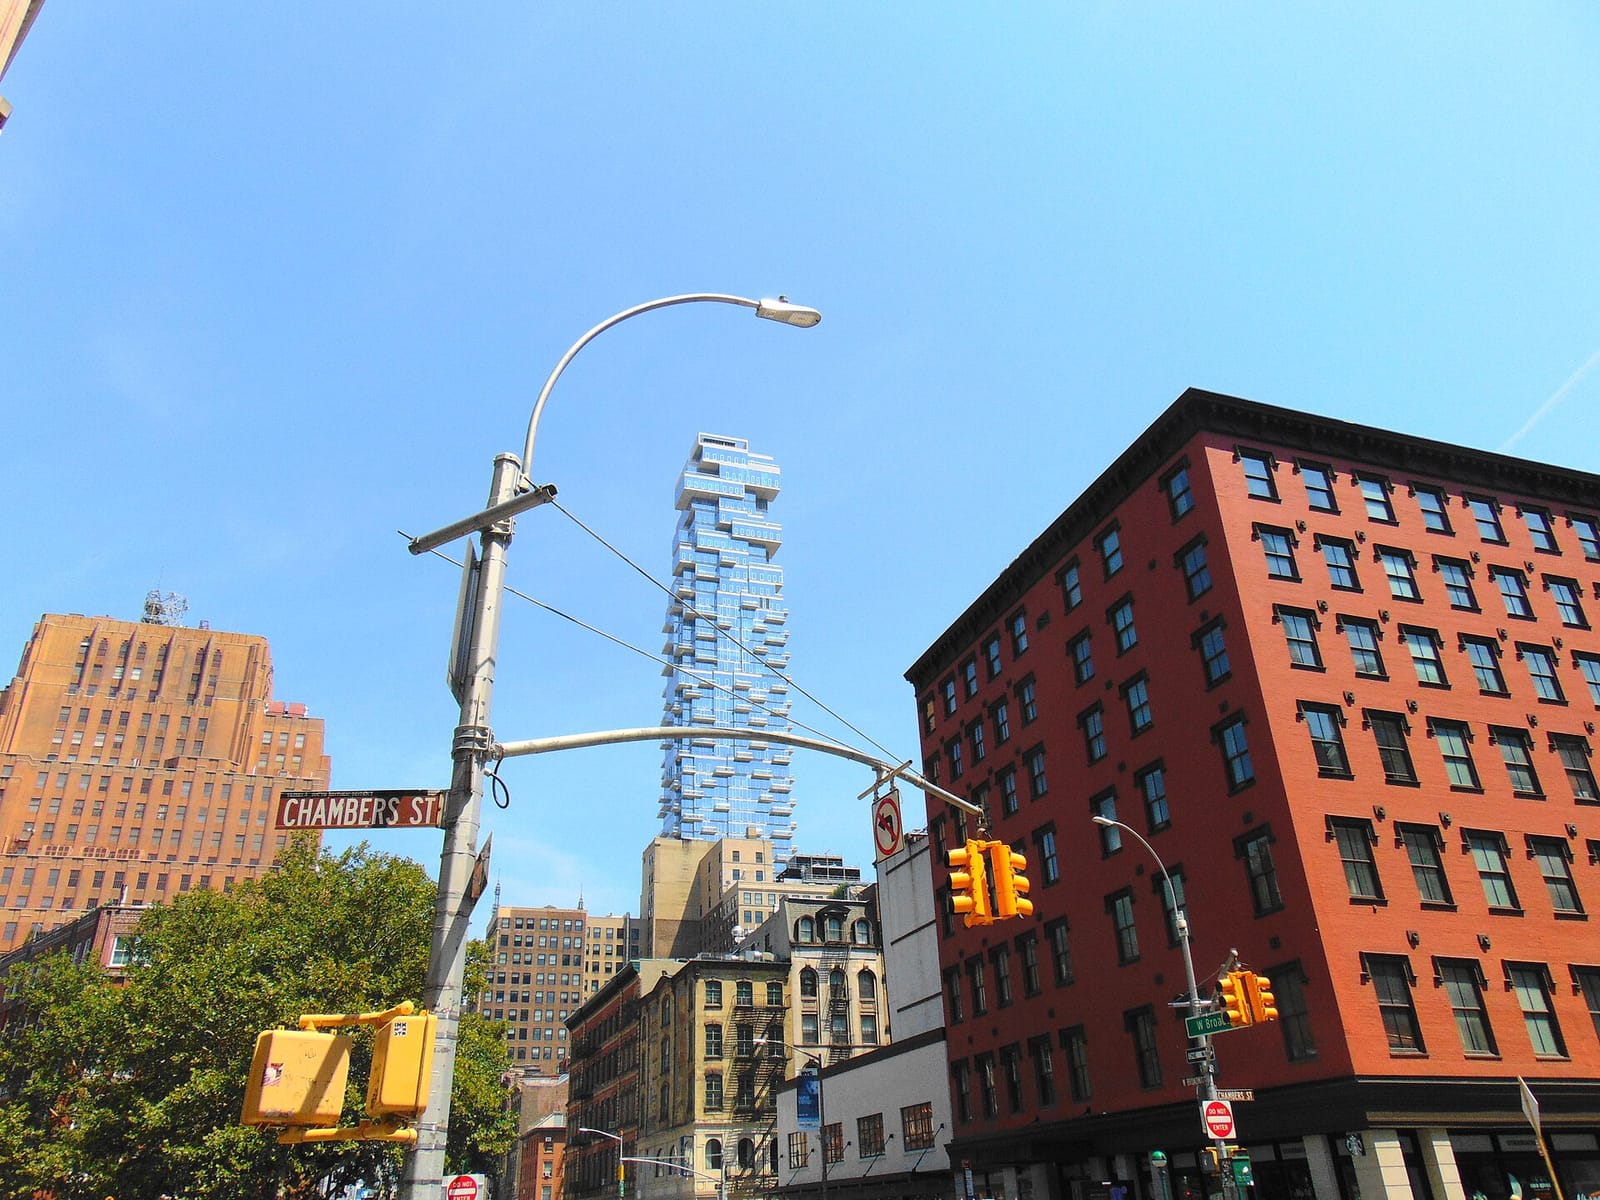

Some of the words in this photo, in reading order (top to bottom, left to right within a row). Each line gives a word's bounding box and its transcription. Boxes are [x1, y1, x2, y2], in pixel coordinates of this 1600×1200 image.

[283, 797, 400, 826] CHAMBERS
[409, 797, 436, 825] ST
[1196, 1019, 1204, 1031] W
[1205, 1017, 1223, 1029] Broa
[1217, 1091, 1243, 1101] CHAMBERS
